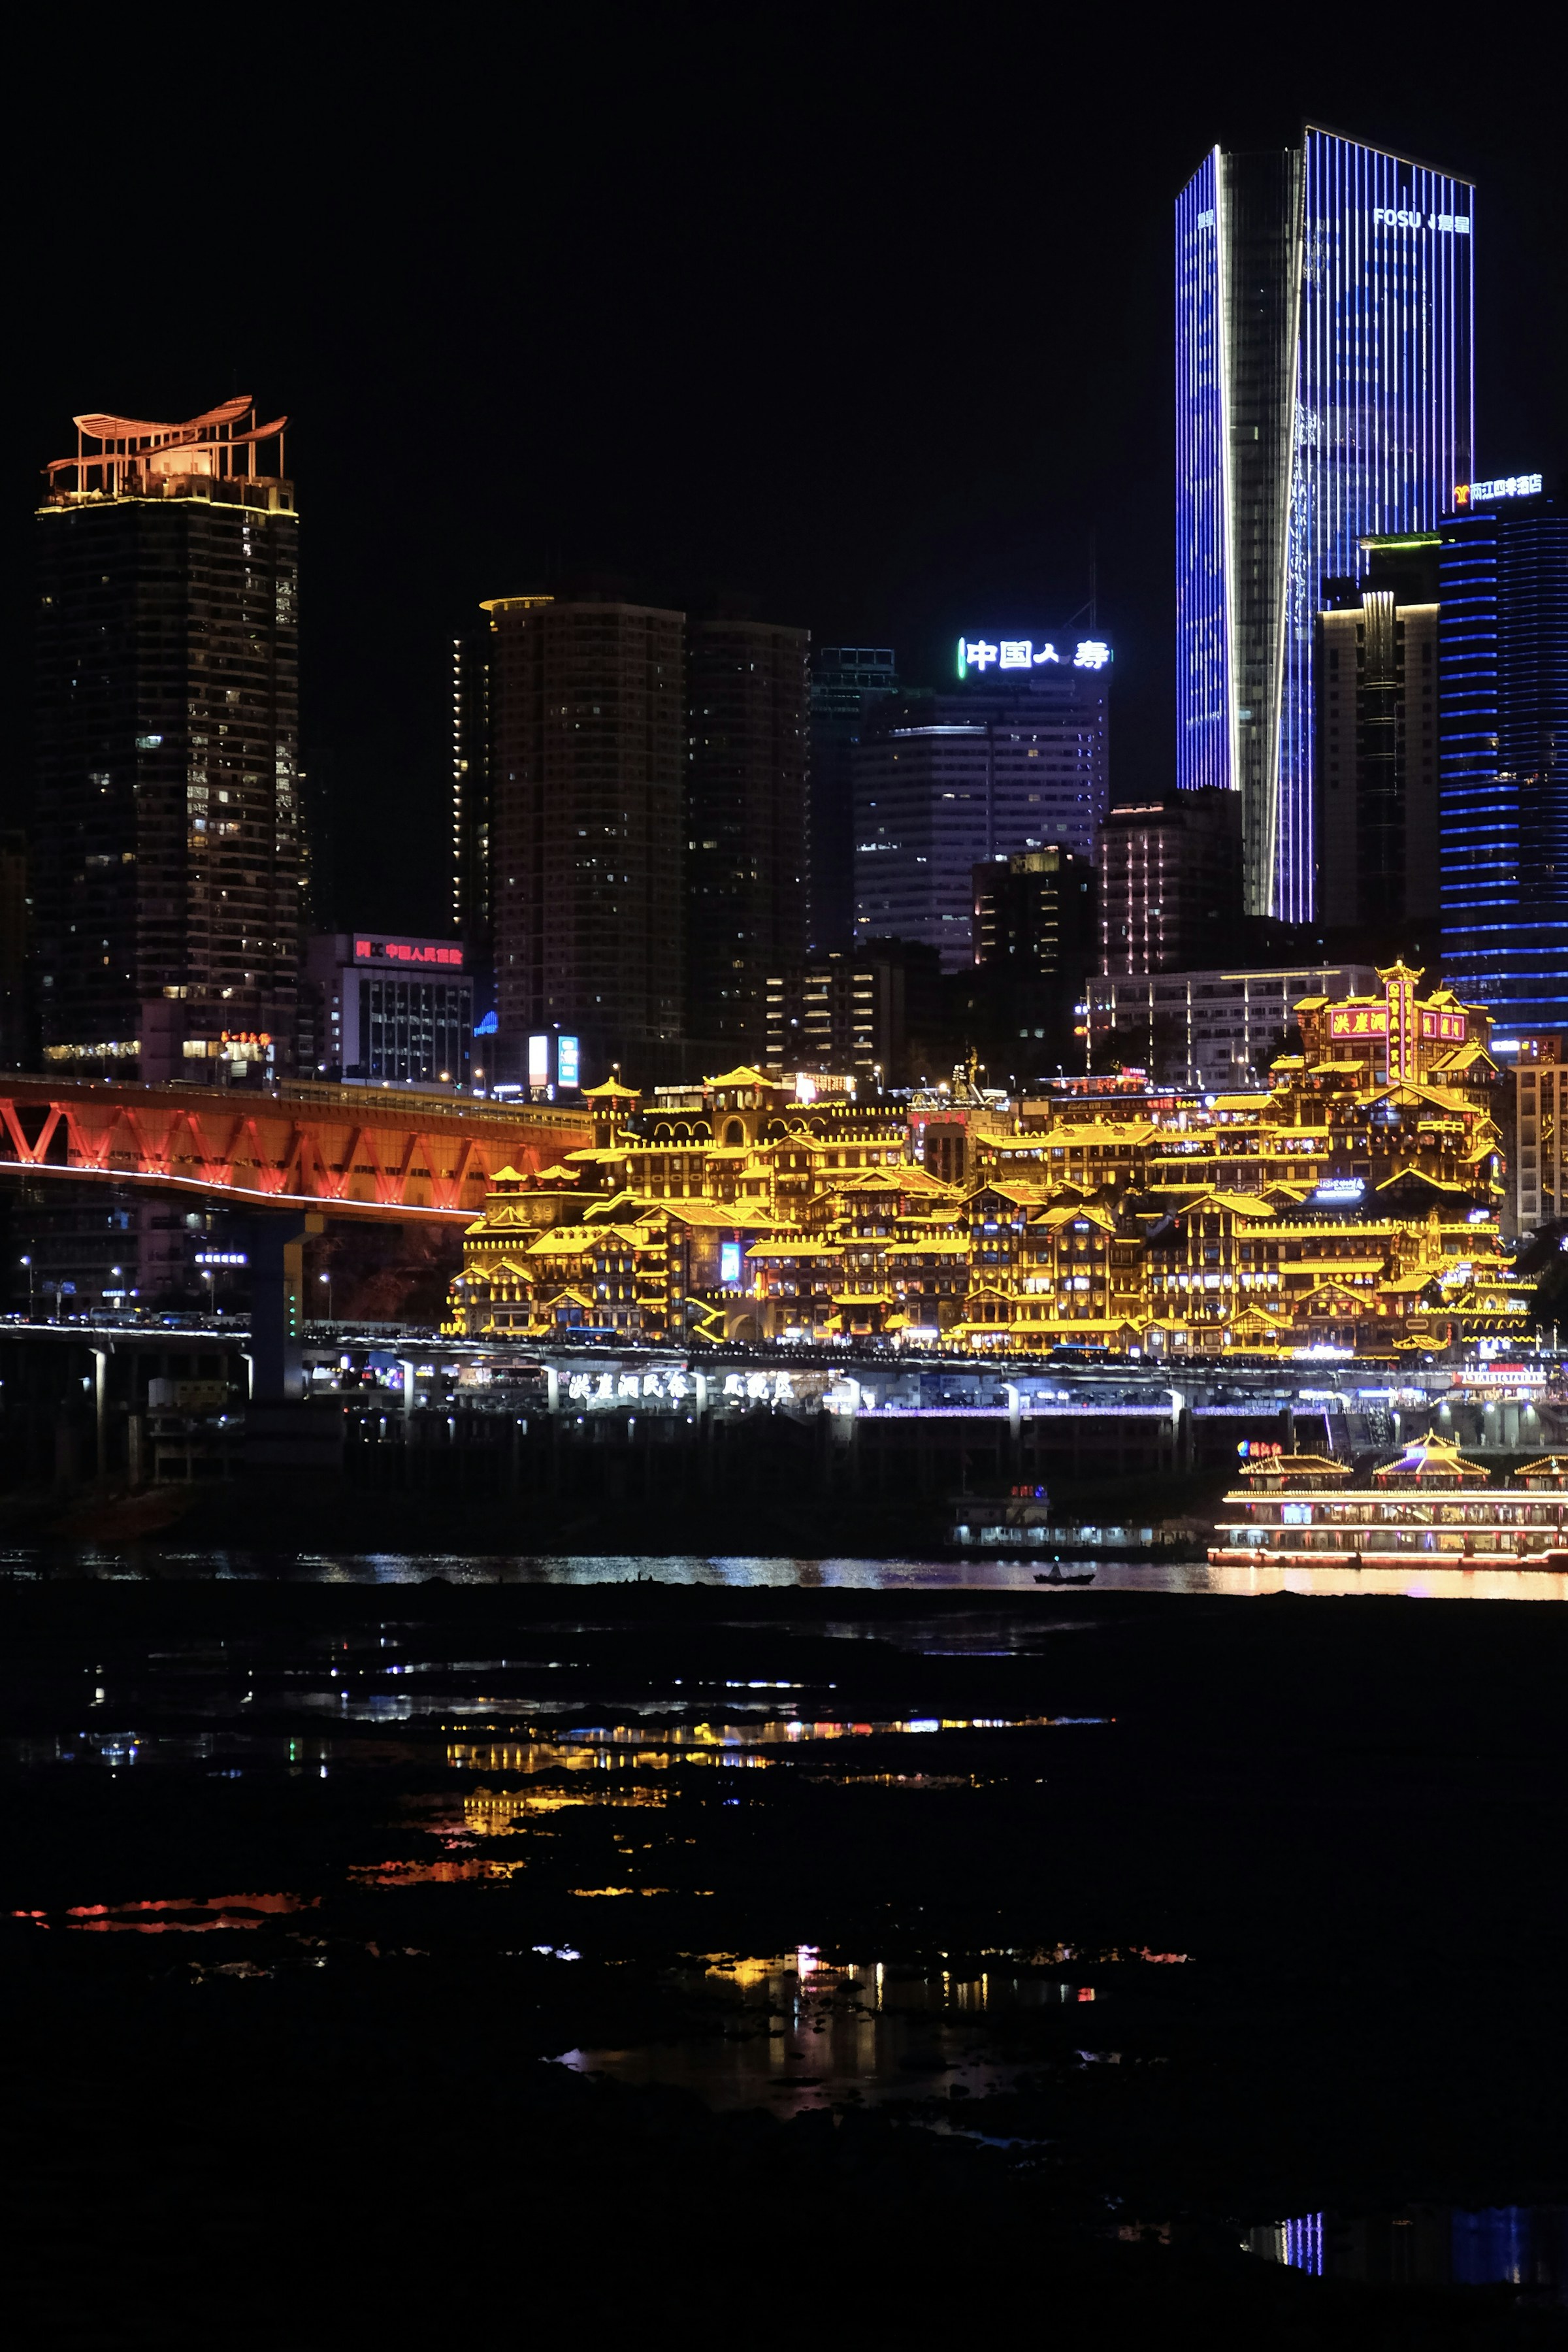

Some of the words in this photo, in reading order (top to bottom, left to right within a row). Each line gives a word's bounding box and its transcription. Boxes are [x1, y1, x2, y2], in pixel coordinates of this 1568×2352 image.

[1438, 214, 1469, 233] 复星
[1470, 474, 1543, 500] 两江四季酒店
[967, 640, 1109, 669] 中国人寿
[386, 943, 463, 965] 中国人民保险
[1333, 1013, 1386, 1034] 洪崖洞
